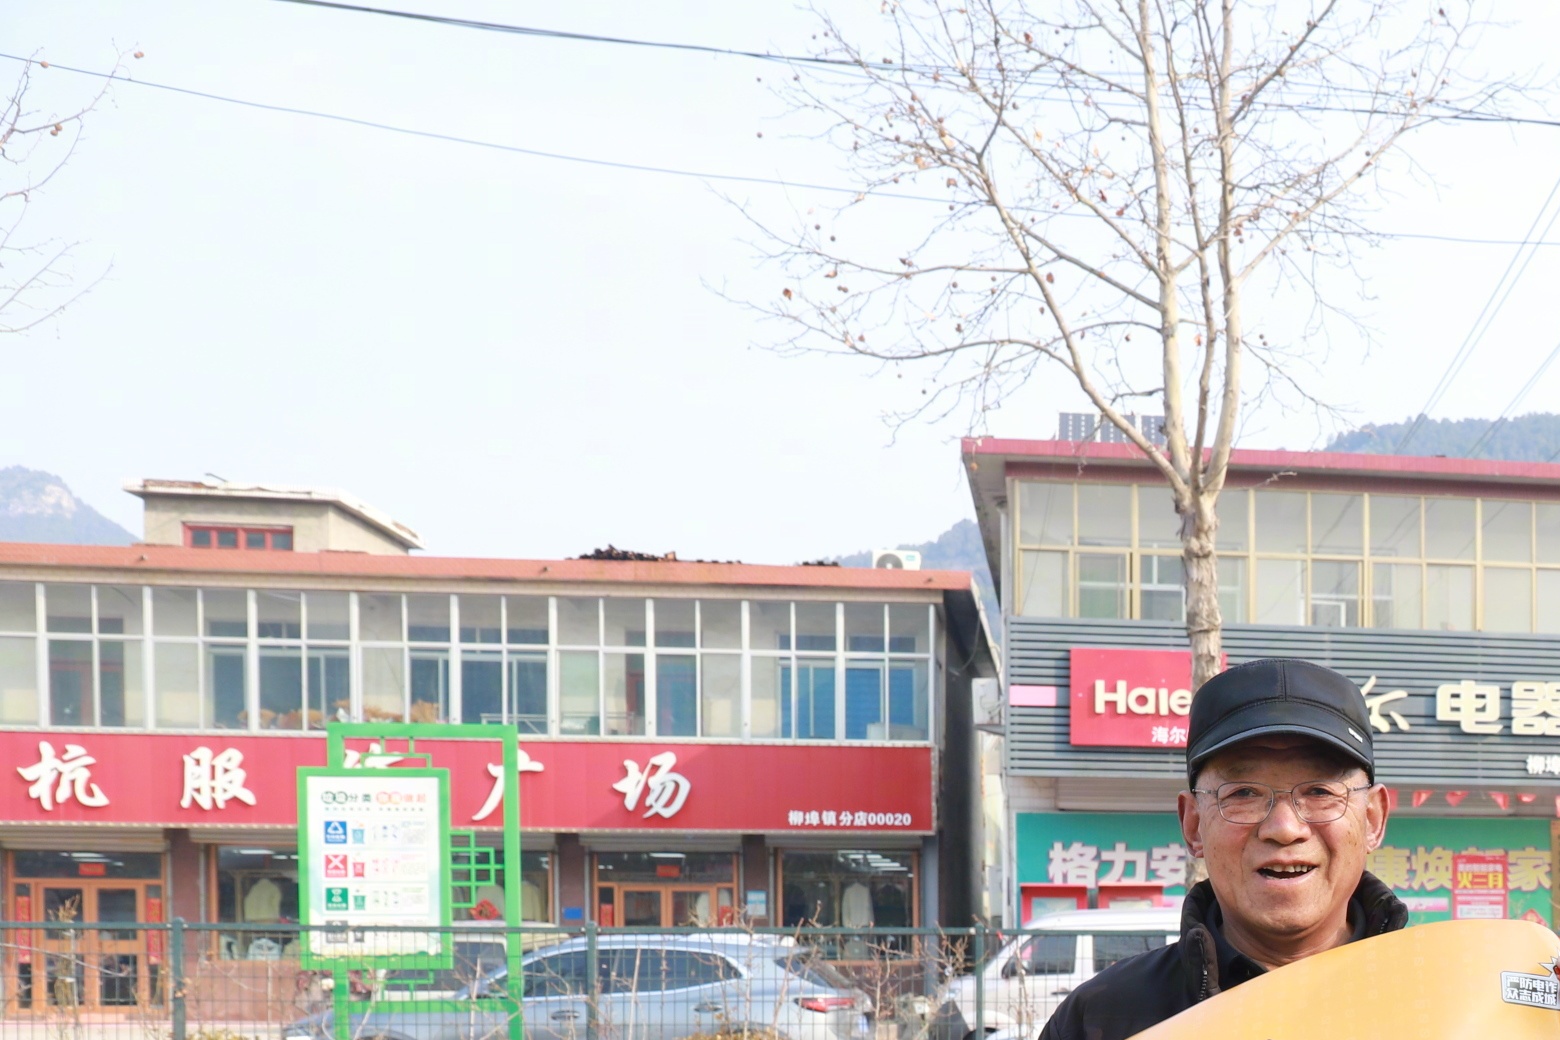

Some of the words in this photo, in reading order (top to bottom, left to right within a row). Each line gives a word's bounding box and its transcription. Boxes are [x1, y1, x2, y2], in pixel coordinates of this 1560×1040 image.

[1094, 680, 1191, 716] Haie
[1151, 726, 1188, 744] 海尔
[788, 810, 912, 826] 柳埠镇分店00020
[1366, 846, 1553, 892] 康焕家
[1506, 975, 1558, 994] 严防电诈
[1506, 988, 1558, 1006] 众志成城
